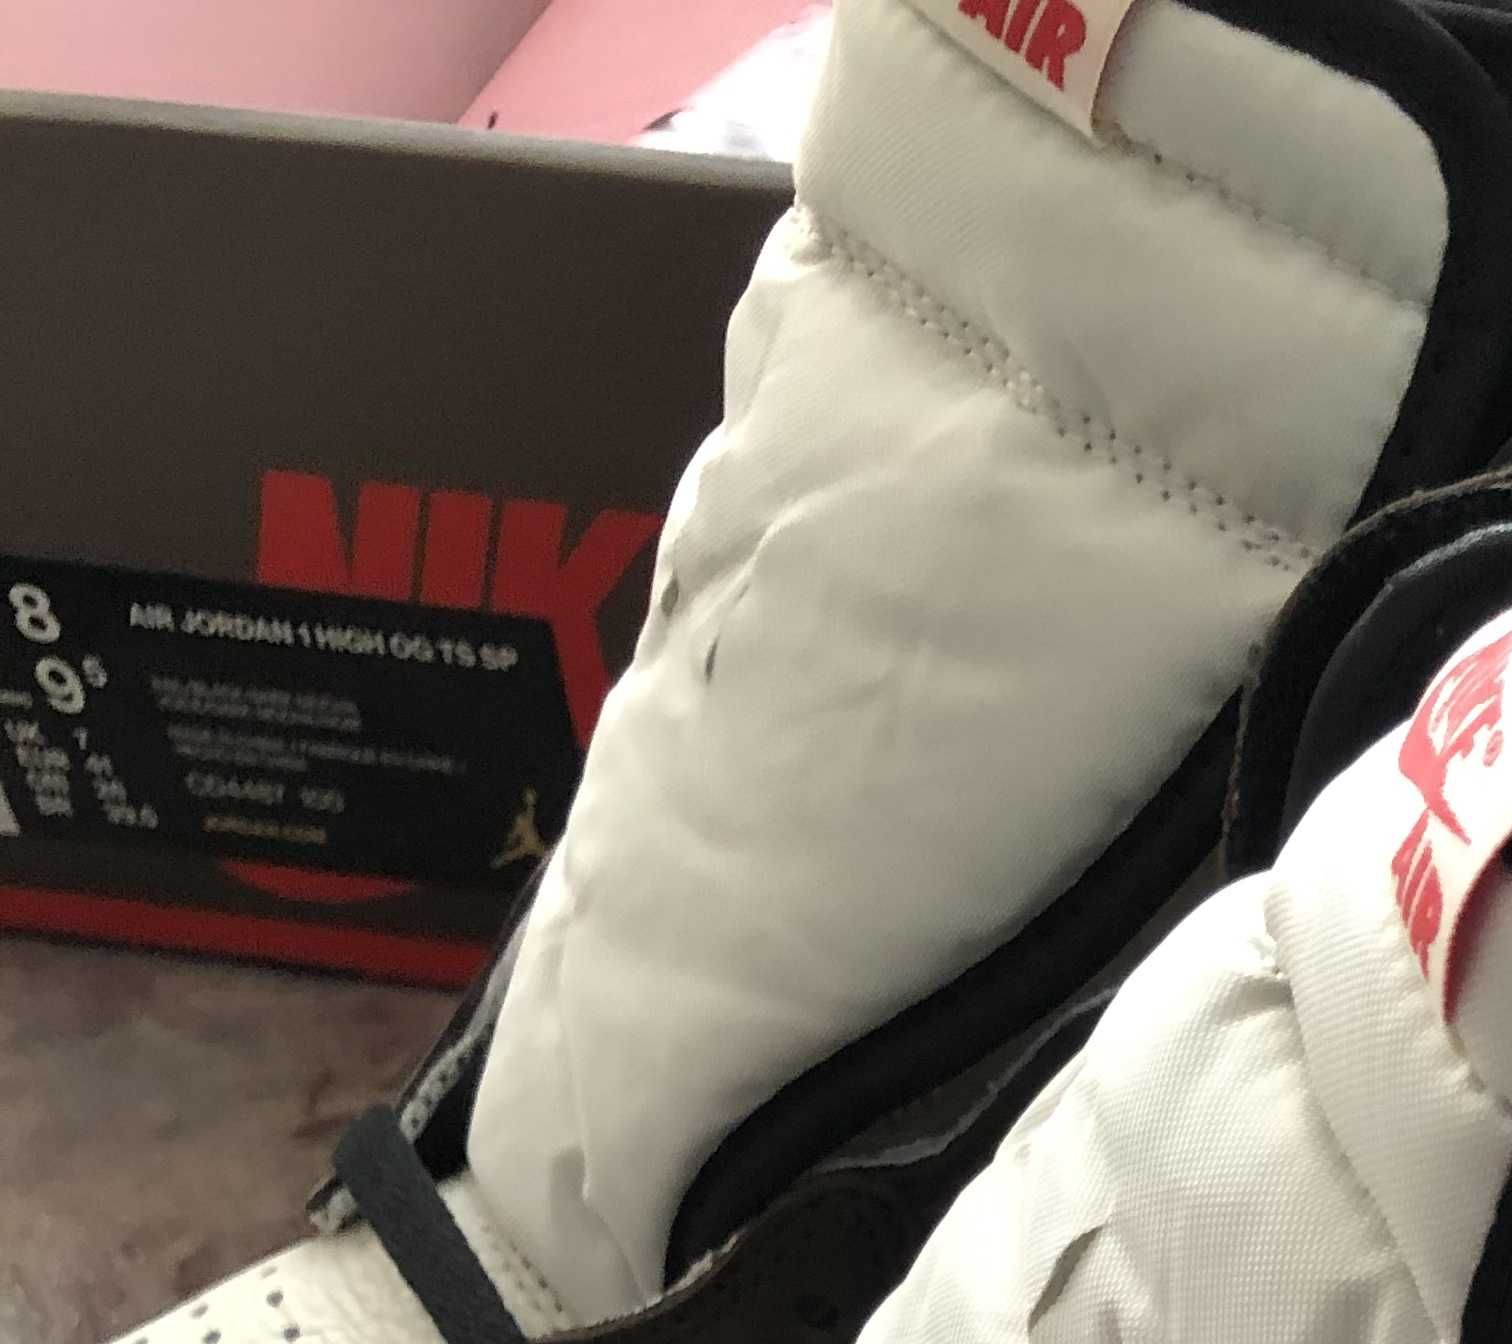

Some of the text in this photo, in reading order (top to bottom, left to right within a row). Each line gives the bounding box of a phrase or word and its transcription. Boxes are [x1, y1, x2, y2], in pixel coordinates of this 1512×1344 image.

[8, 582, 61, 645] 8
[181, 607, 295, 645] JORDAN
[314, 622, 386, 657] HIGH
